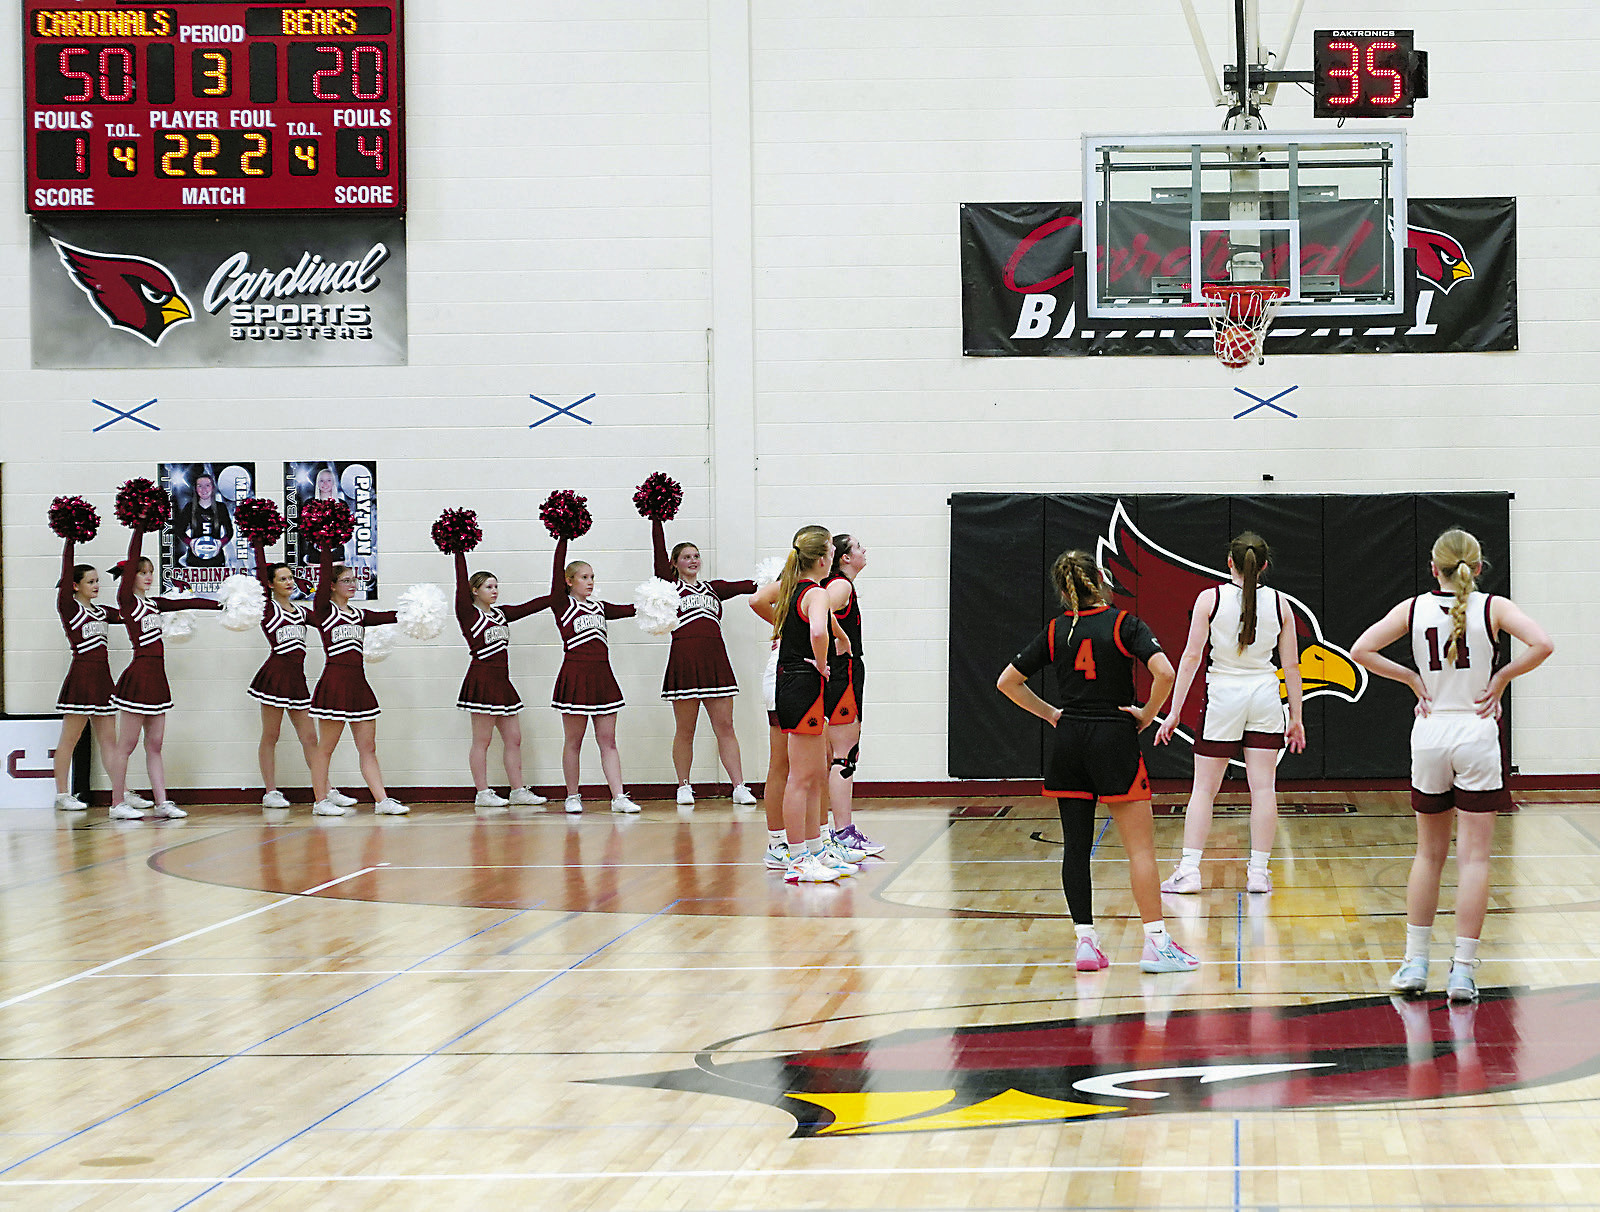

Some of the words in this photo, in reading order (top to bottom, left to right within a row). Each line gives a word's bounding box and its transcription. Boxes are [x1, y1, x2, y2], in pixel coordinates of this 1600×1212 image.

[36, 10, 171, 37] CARDINALS
[180, 25, 244, 43] PERIOD
[282, 9, 358, 35] BEARS
[1332, 30, 1396, 38] DAKTRONICS
[59, 48, 133, 101] 50
[202, 52, 227, 95] 3
[312, 46, 384, 100] 20
[1328, 42, 1401, 105] 35
[34, 111, 93, 129] FOULS
[105, 123, 141, 137] T.O.L.
[150, 110, 218, 129] PLAYER
[230, 109, 276, 128] FOUL
[287, 122, 322, 136] T.O.L.
[333, 109, 392, 127] FOULS
[75, 137, 86, 174] 1
[112, 146, 136, 172] 4
[294, 145, 316, 170] 4
[357, 135, 384, 171] 4
[34, 188, 94, 206] SCORE
[182, 187, 246, 205] MATCH
[334, 186, 393, 204] SCORE
[202, 242, 390, 314] Cardinal
[229, 304, 371, 325] SPORTS
[229, 326, 372, 340] BOOSTERS
[356, 476, 372, 555] PAYTON
[1074, 638, 1097, 680] 4
